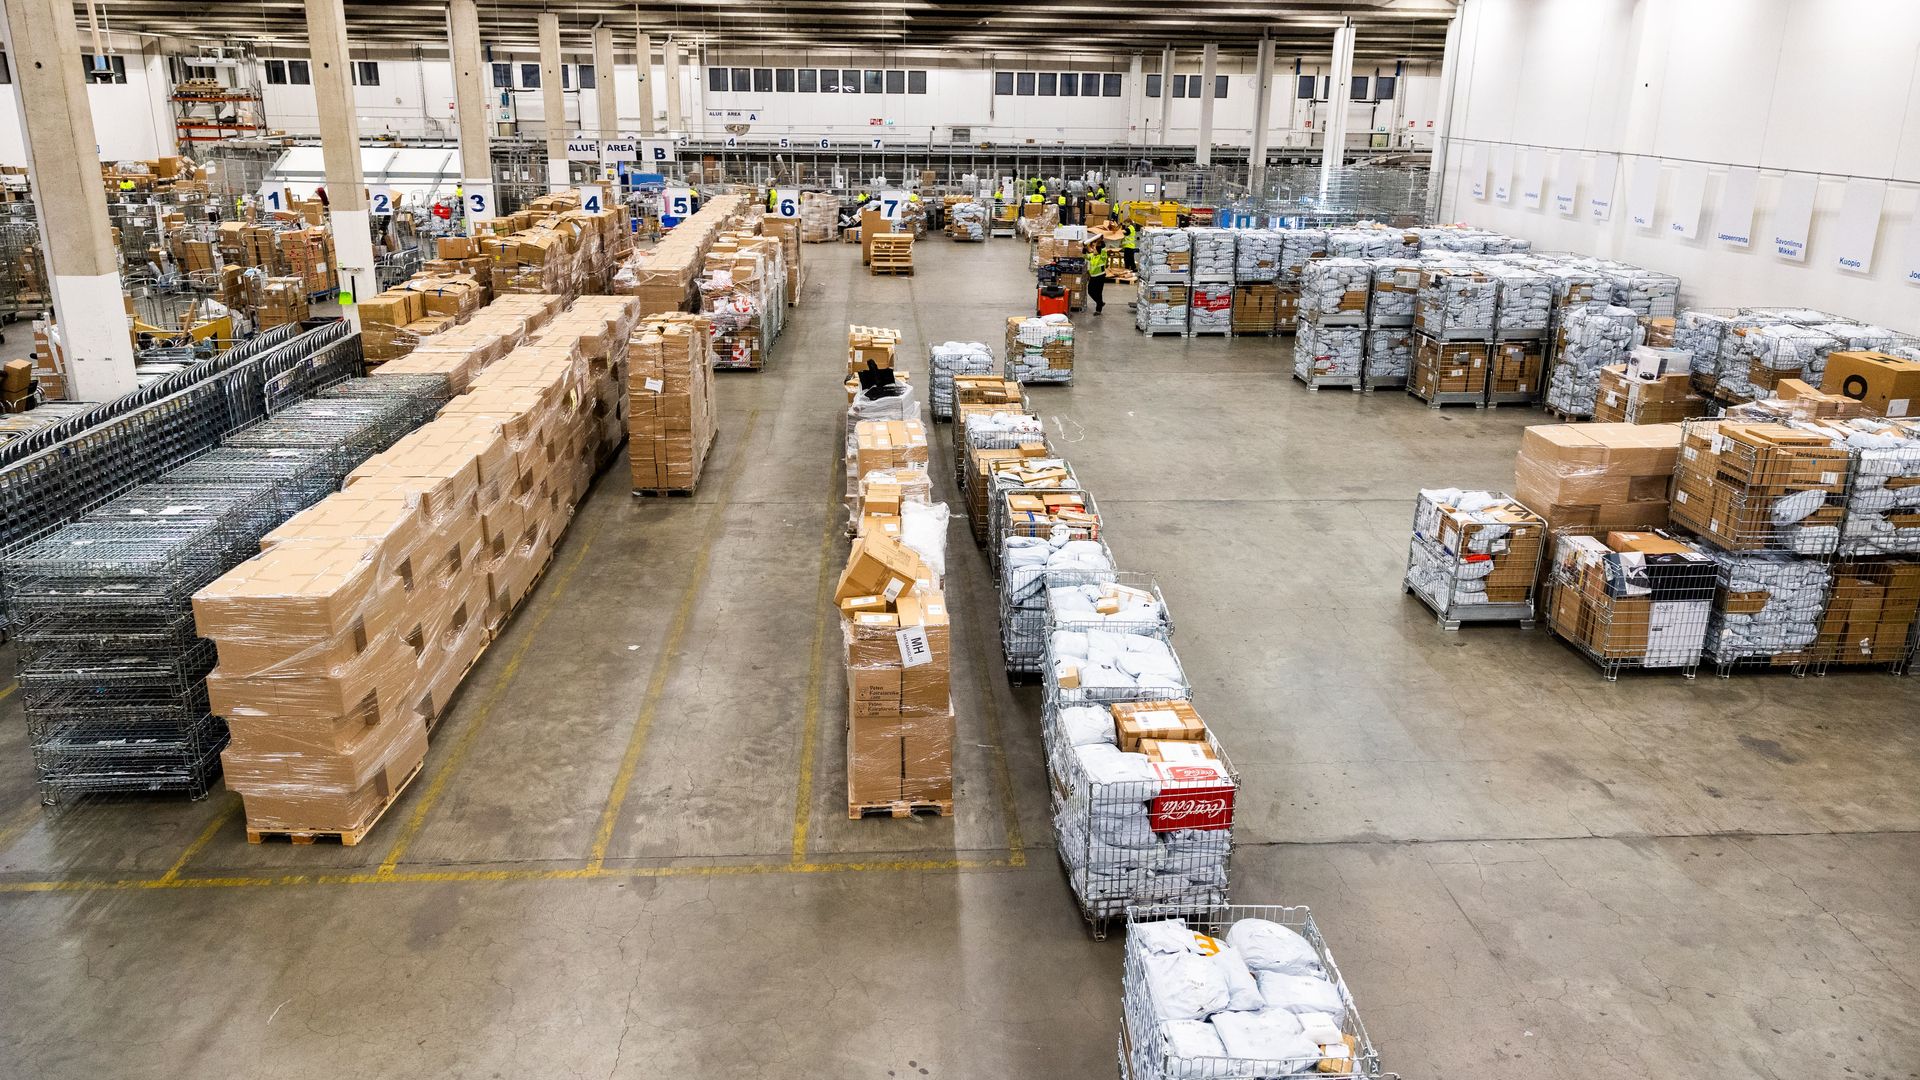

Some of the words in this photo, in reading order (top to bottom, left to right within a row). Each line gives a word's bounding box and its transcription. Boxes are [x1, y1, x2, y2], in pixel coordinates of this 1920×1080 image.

[728, 138, 736, 147] 4
[781, 138, 788, 148] 5
[821, 139, 829, 149] 6
[874, 139, 881, 149] 7
[568, 144, 596, 152] ALUE
[606, 144, 634, 152] AREA
[654, 147, 666, 160] B
[267, 191, 281, 210] 1
[373, 194, 390, 213] 2
[470, 194, 486, 212] 3
[584, 195, 601, 214] 4
[674, 197, 688, 214] 5
[780, 199, 796, 217] 6
[884, 200, 899, 218] 7
[1672, 223, 1684, 232] Turku
[1718, 232, 1748, 244] Lappeenranta
[1775, 237, 1803, 249] Savonlinna
[1778, 246, 1797, 257] Mikkeli
[1839, 257, 1861, 268] Kuopio
[911, 637, 924, 655] MH
